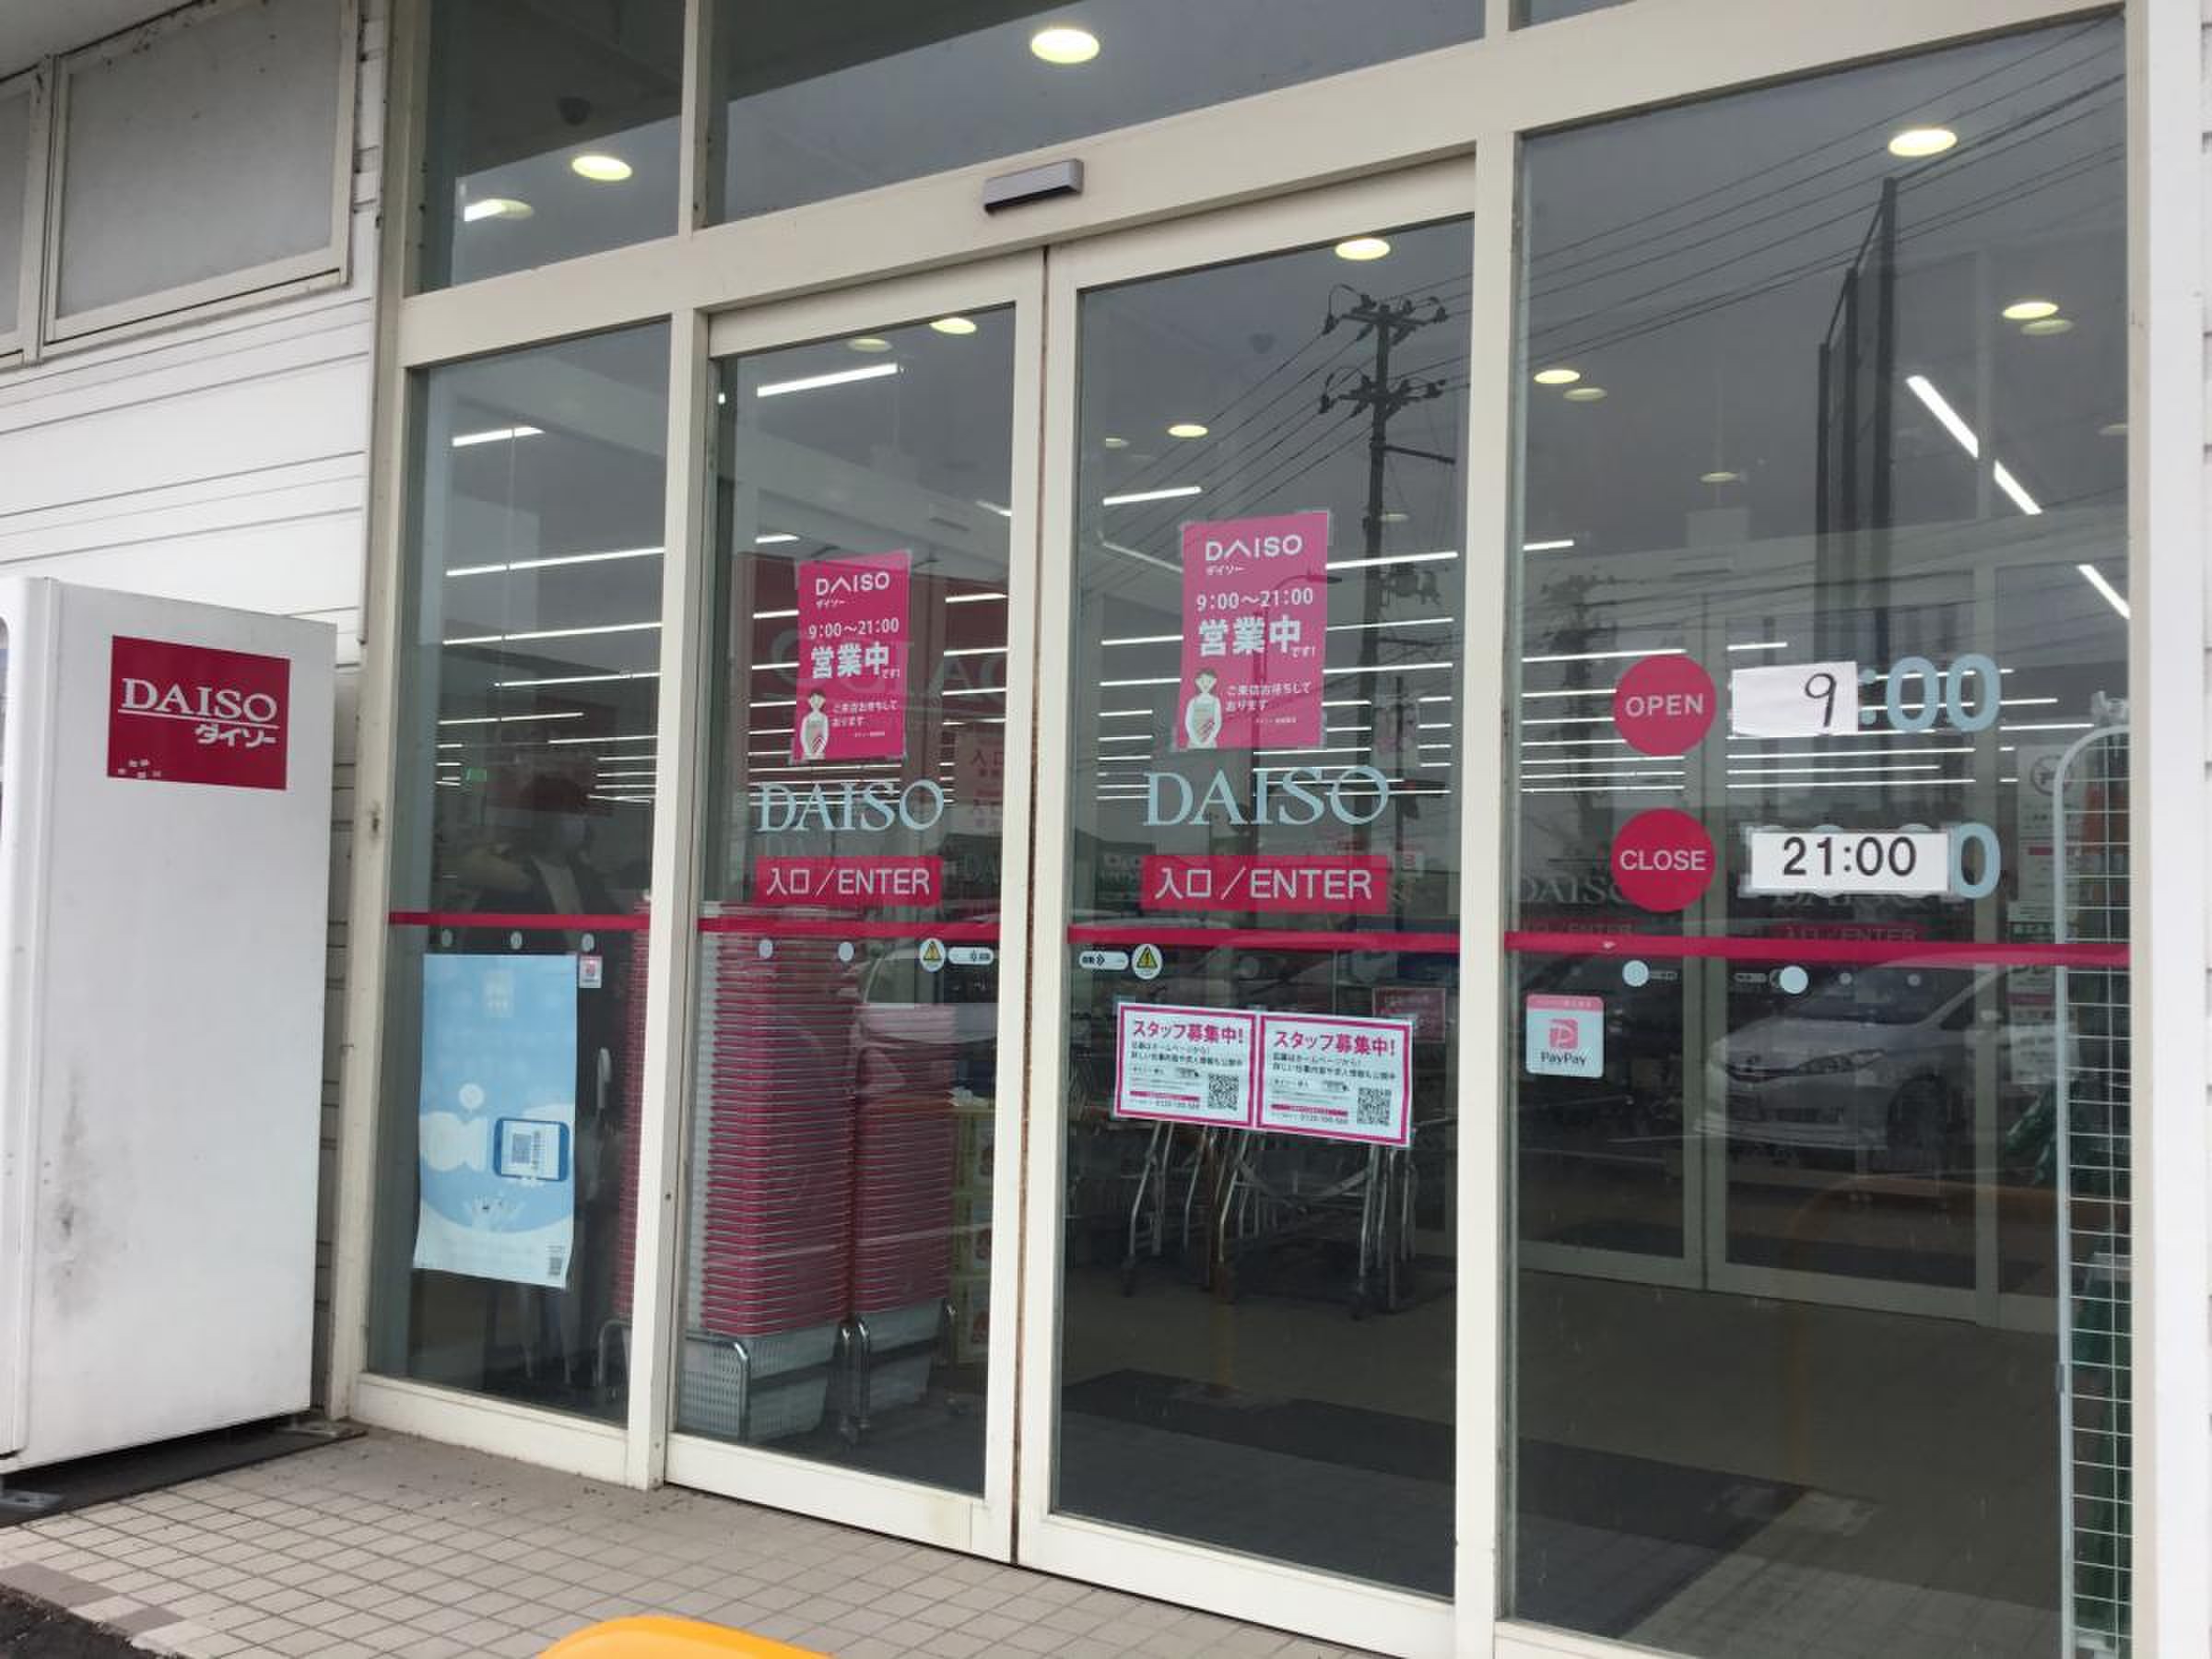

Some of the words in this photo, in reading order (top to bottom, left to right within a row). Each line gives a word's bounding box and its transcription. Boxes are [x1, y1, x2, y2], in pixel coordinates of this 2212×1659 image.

[1205, 534, 1302, 561] DAISO
[816, 571, 889, 596] DAISO
[1198, 615, 1301, 657] 営業中
[810, 642, 889, 679] 営業中
[122, 677, 276, 724] DAISO
[1625, 693, 1704, 717] OPEN
[194, 723, 276, 748] ダイソー
[756, 779, 944, 832] DAISO
[1142, 765, 1391, 827] DAISO
[1619, 849, 1707, 871] CLOSE
[1782, 836, 1917, 877] 21:00
[1520, 870, 1622, 904] DAIS
[1273, 1030, 1396, 1057] スタッフ募集中!
[1541, 1052, 1587, 1066] PayPay
